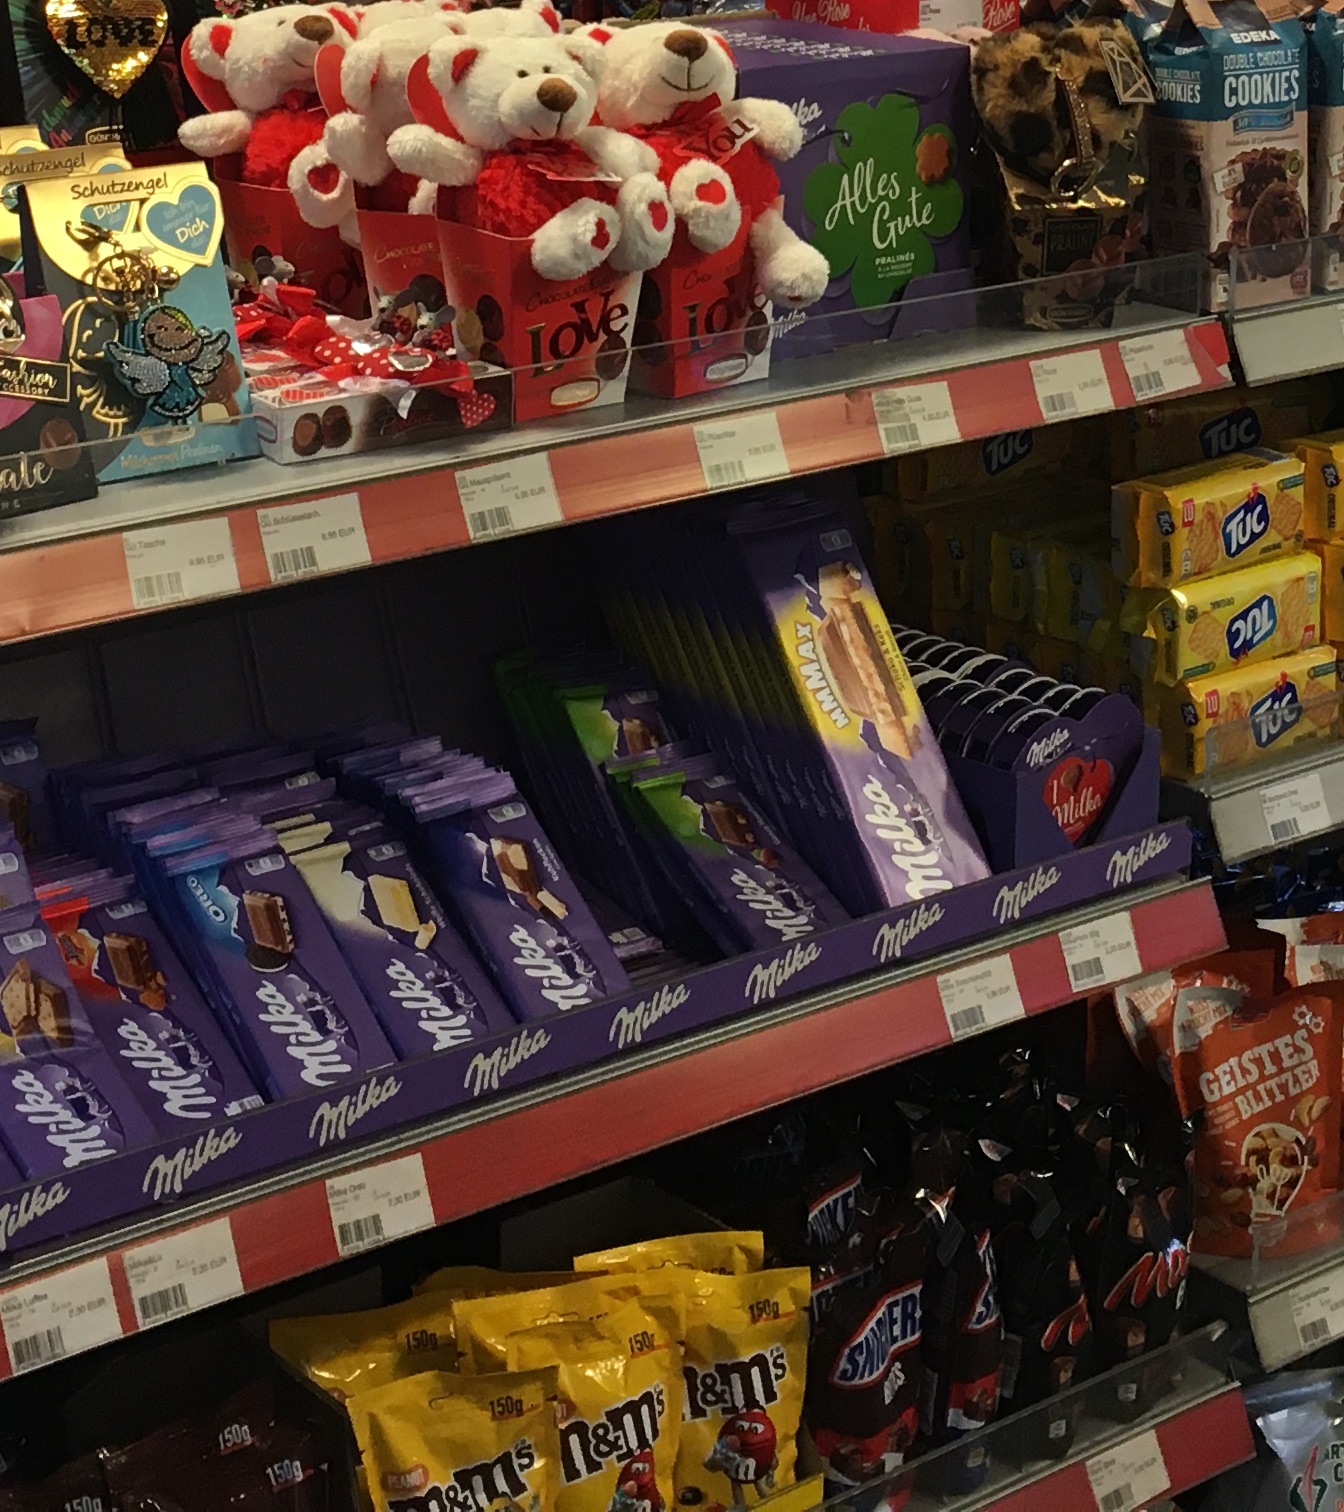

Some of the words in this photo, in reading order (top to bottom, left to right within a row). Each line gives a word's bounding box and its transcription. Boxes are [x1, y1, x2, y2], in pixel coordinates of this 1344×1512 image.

[1230, 28, 1282, 45] EDEKA
[1223, 52, 1255, 72] DOUBLE
[1223, 74, 1301, 109] COOKIES
[70, 172, 169, 200] Schutzengel
[824, 159, 901, 232] Alles
[175, 216, 209, 244] Dich
[871, 201, 937, 256] Gute
[1225, 510, 1267, 555] TUC
[1229, 604, 1276, 645] TUC
[1051, 790, 1103, 825] Milka
[862, 776, 953, 902] Milka
[1105, 831, 1172, 888] Milka
[185, 875, 228, 923] OREO
[256, 980, 352, 1087] Milka
[464, 1028, 551, 1096] Milka
[1198, 1028, 1315, 1104] GEISTES
[1234, 1059, 1320, 1121] BLITZER
[88, 1297, 107, 1313] EUR
[404, 1330, 438, 1351] 150g
[265, 1459, 304, 1484] 150g
